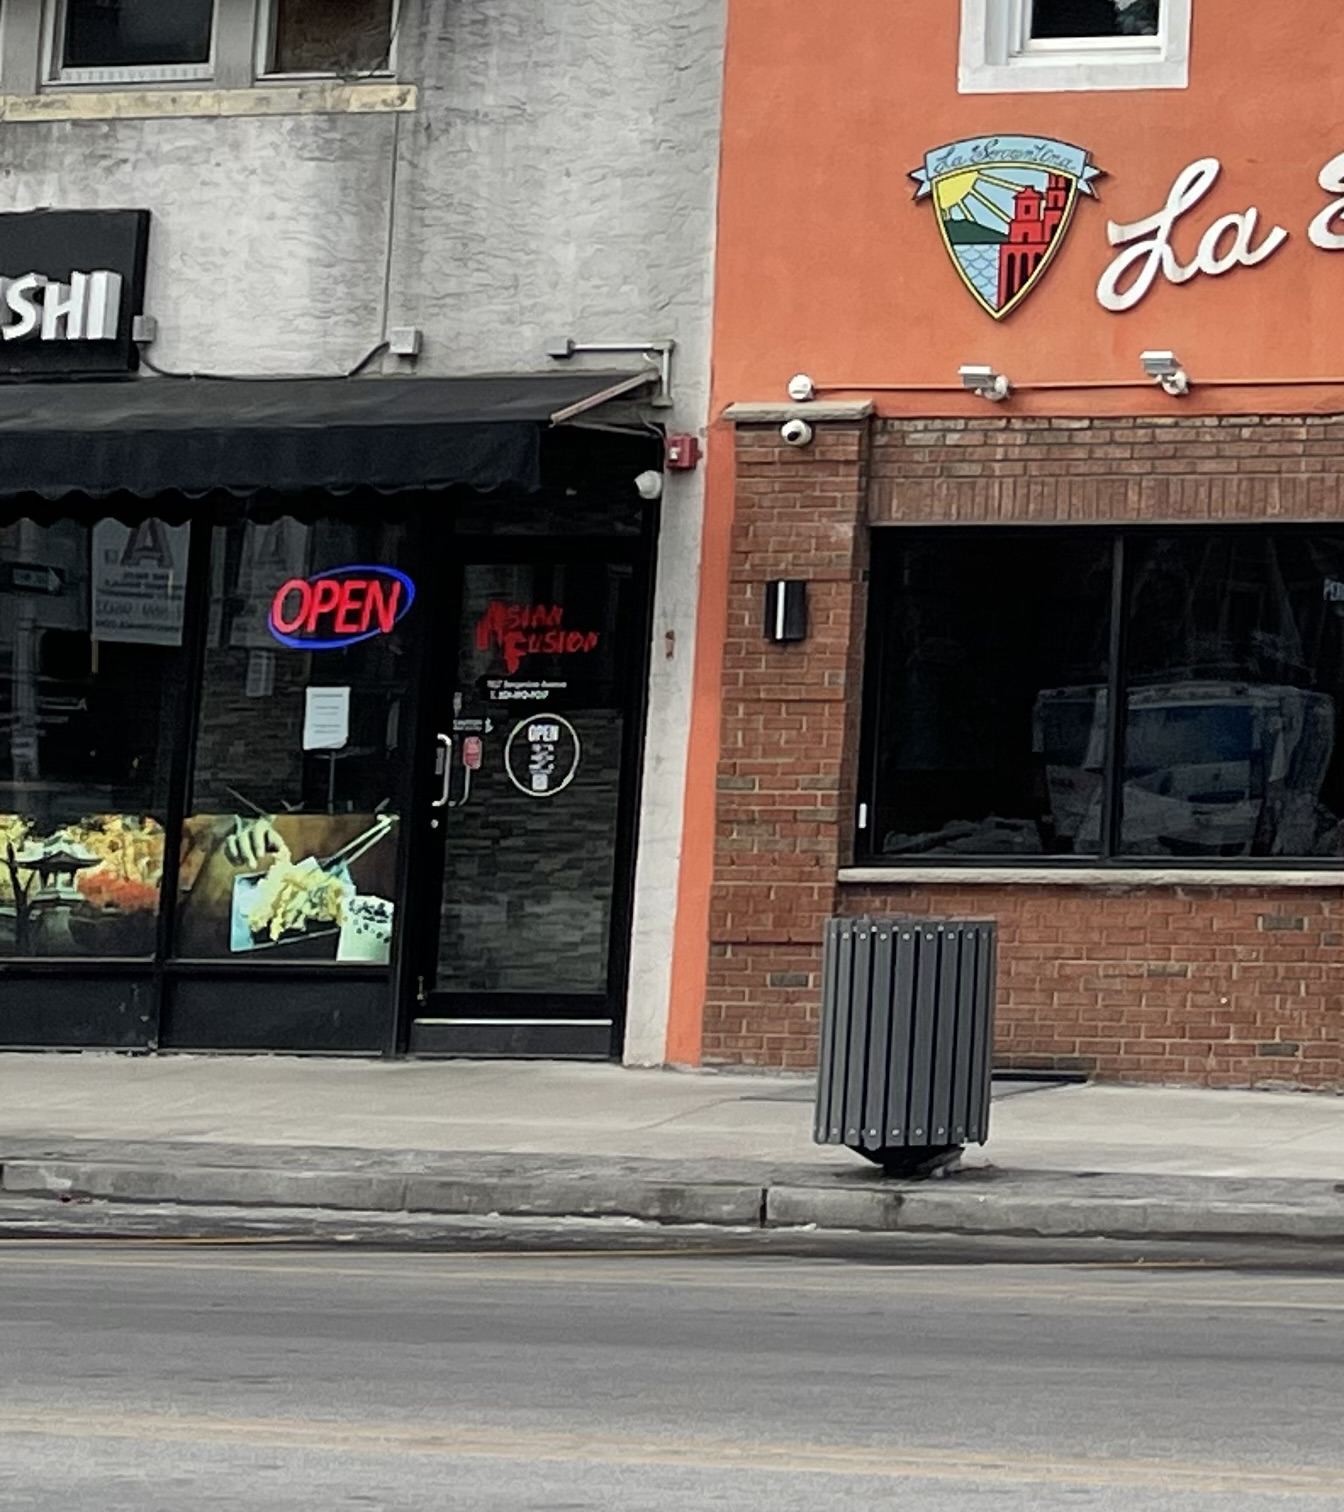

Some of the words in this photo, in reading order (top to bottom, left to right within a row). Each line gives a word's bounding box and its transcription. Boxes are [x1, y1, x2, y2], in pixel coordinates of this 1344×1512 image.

[933, 146, 967, 174] La
[1097, 157, 1288, 313] La
[271, 577, 401, 635] OPEN
